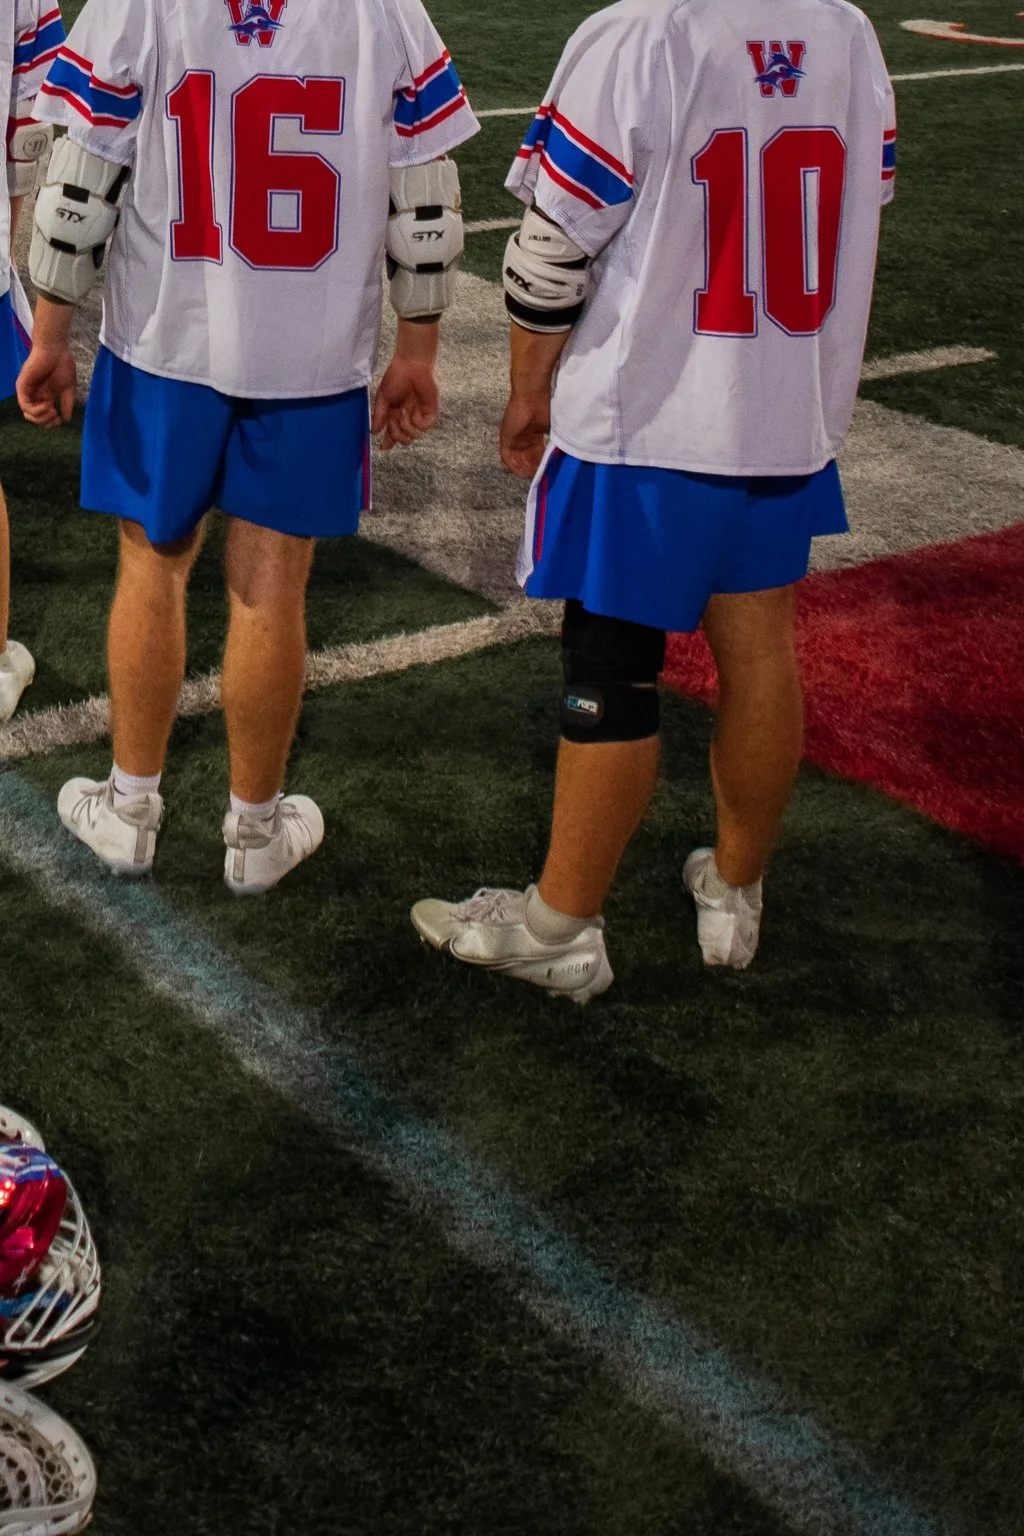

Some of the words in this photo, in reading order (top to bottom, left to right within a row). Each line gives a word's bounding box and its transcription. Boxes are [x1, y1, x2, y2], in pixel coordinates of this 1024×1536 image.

[745, 40, 806, 98] W
[166, 69, 345, 272] 16
[55, 207, 88, 224] STX
[412, 229, 445, 243] STX
[690, 125, 848, 338] 10
